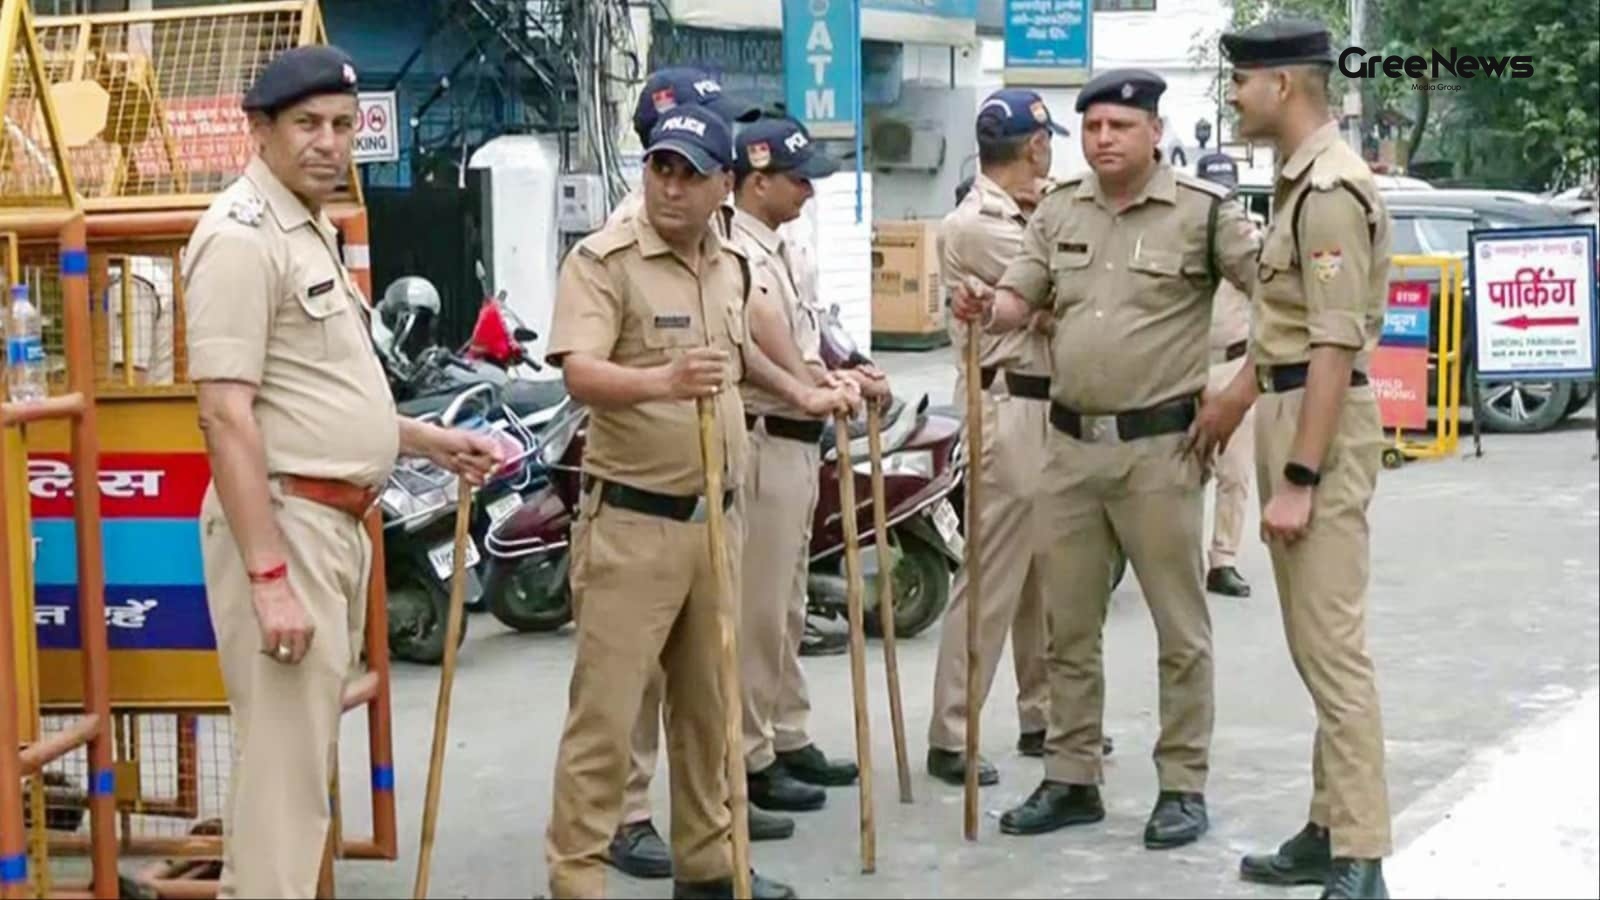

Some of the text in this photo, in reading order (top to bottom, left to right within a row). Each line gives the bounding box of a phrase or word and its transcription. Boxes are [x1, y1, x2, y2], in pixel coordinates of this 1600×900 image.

[805, 19, 835, 120] ATM
[353, 135, 387, 150] KING
[661, 116, 707, 137] POLICE
[1488, 267, 1577, 309] पार्किंग
[27, 459, 166, 498] लिस
